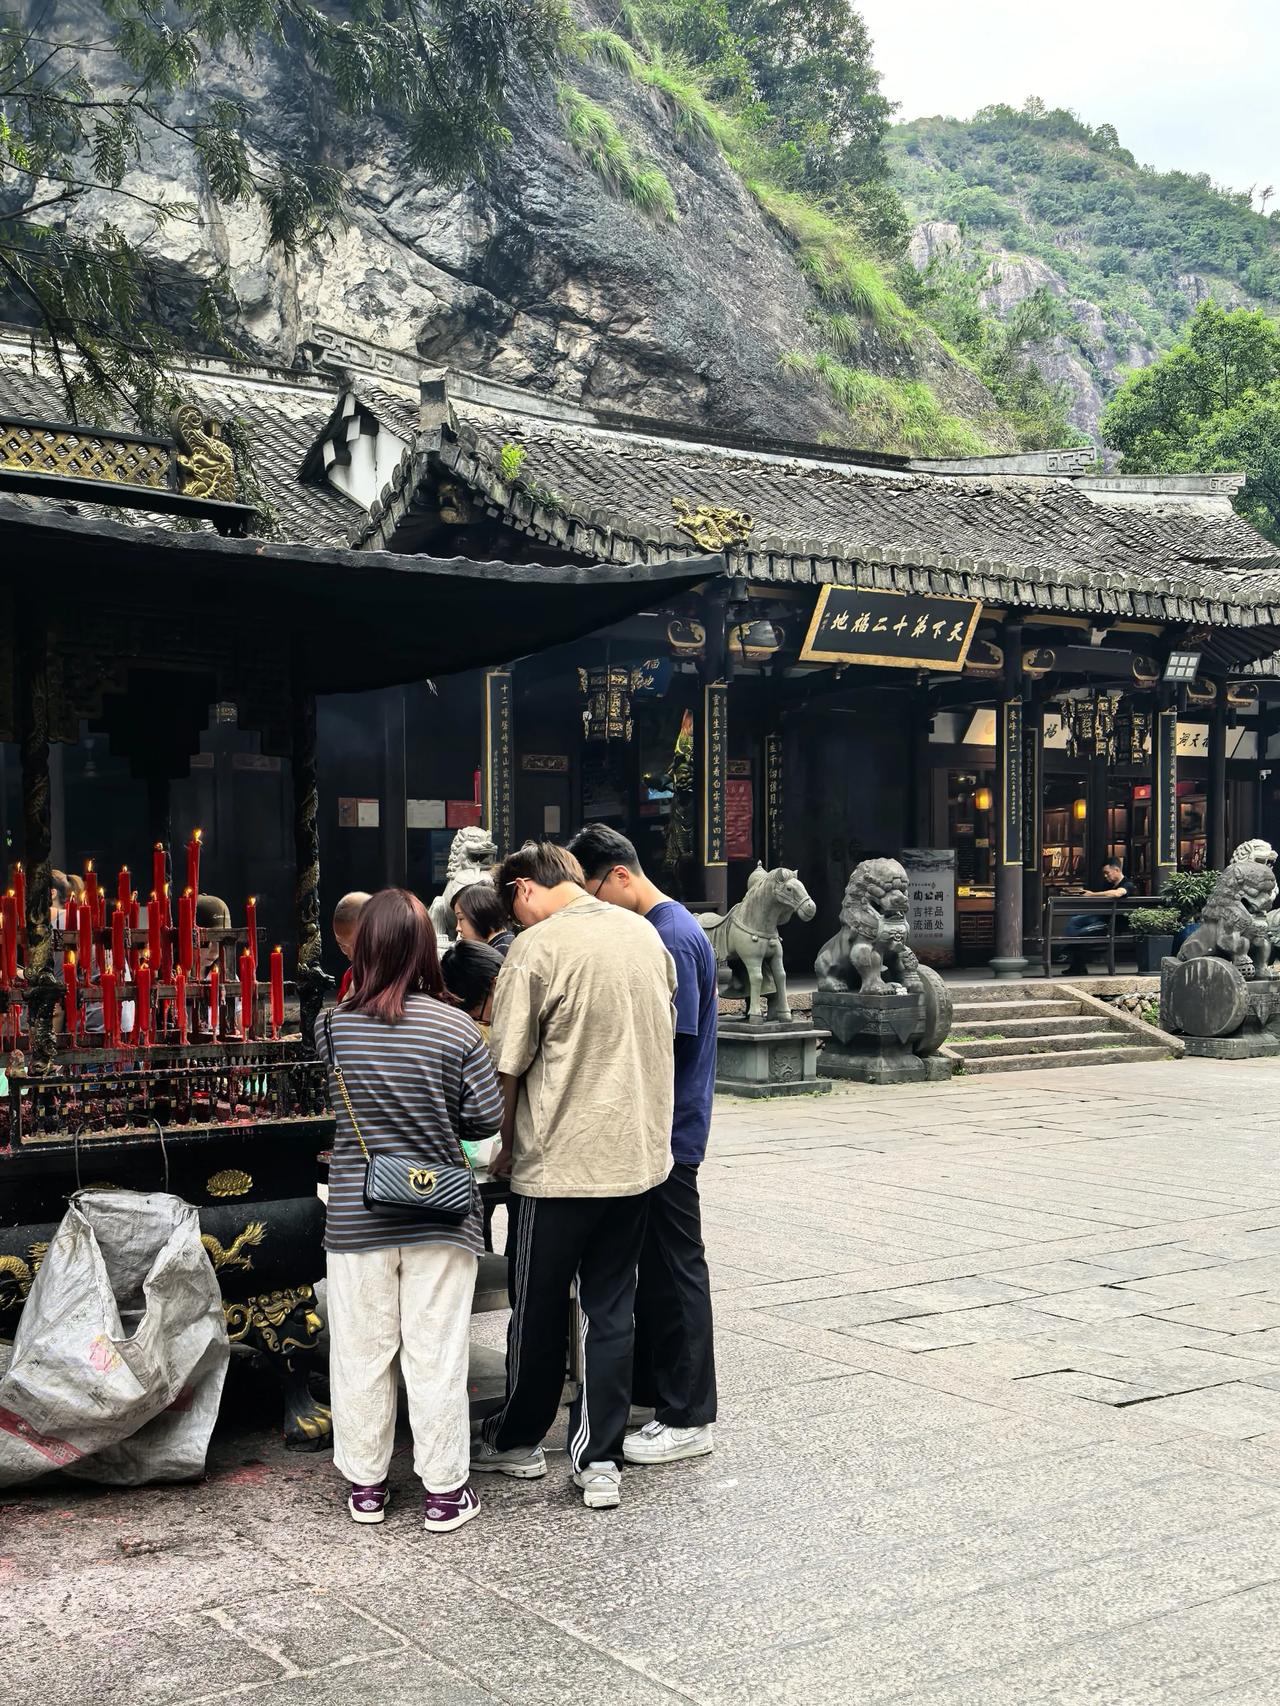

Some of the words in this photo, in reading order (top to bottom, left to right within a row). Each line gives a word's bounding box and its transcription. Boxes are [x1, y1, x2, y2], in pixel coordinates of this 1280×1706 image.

[830, 610, 964, 642] 天下第十二福地
[913, 906, 944, 917] 吉祥品
[913, 919, 944, 930] 流通处
